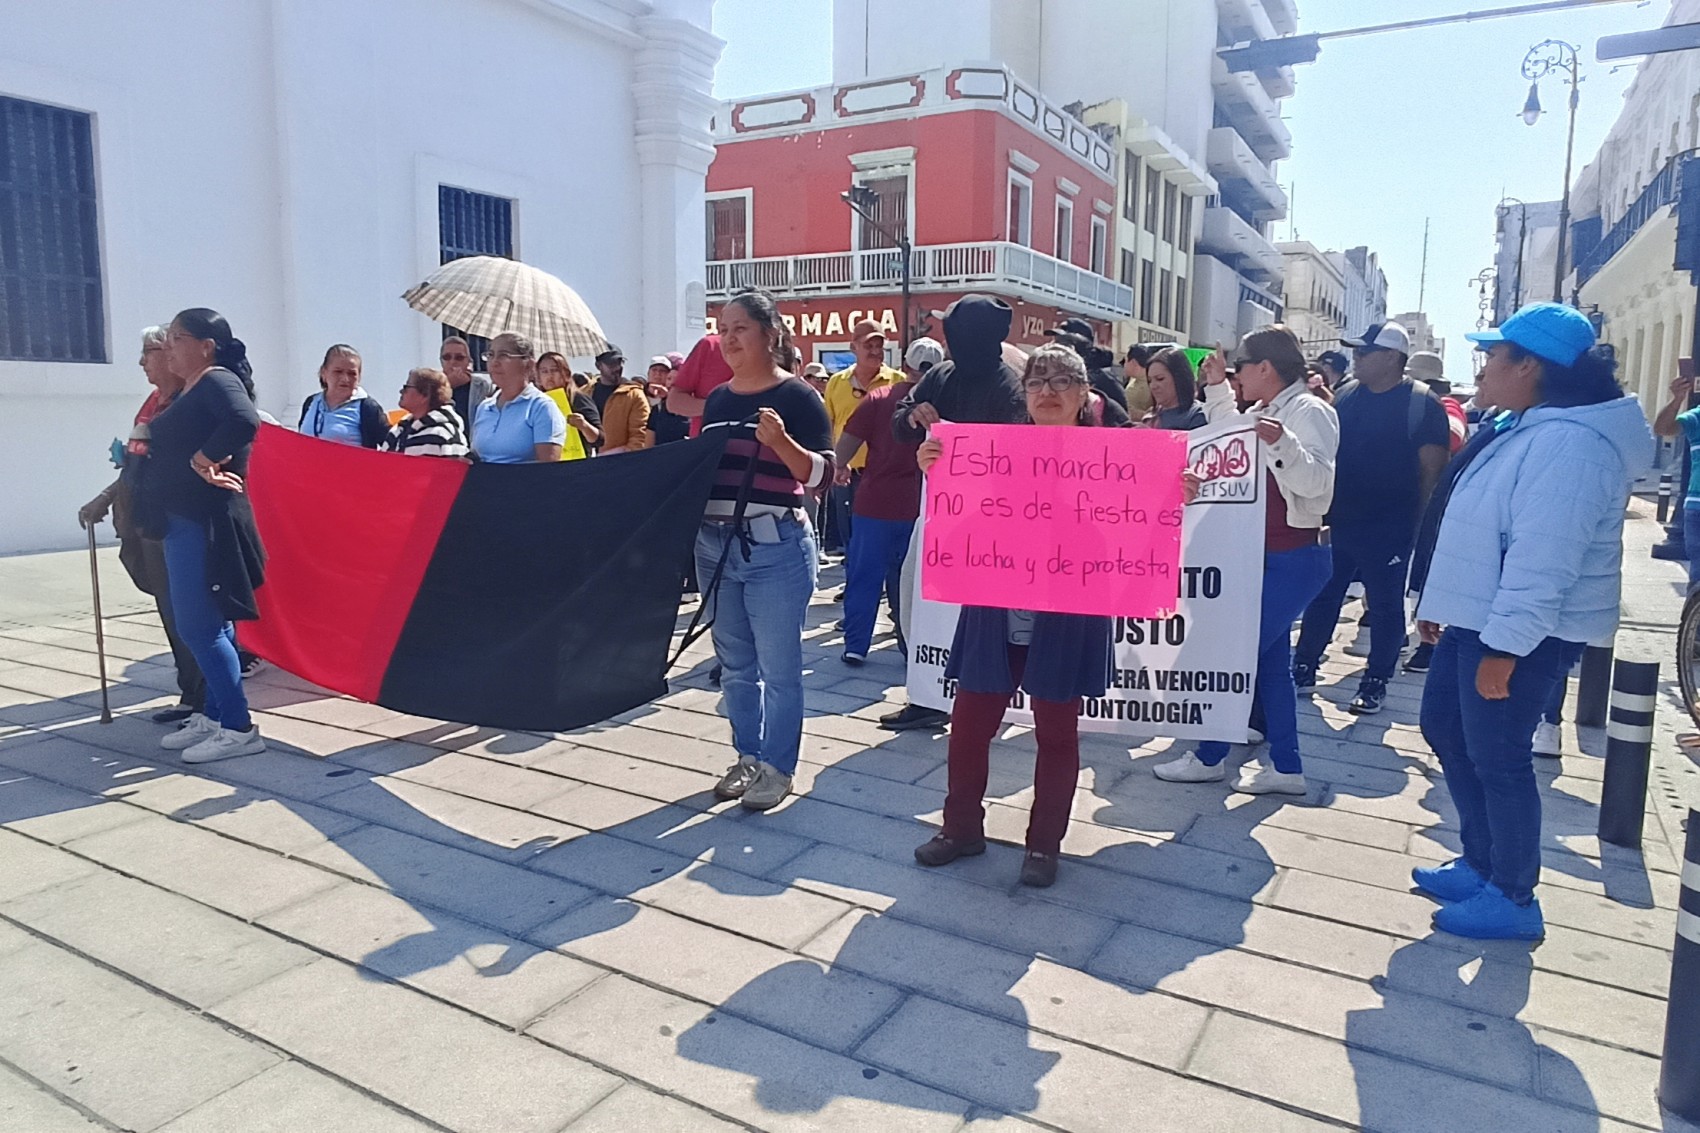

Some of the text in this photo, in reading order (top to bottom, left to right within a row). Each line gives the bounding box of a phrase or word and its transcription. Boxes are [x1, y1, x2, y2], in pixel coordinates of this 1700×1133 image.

[949, 435, 1137, 485] Esta marcha
[934, 490, 1183, 528] no es de fiesta es
[926, 533, 1170, 587] de lucha y de protesta
[1178, 566, 1222, 599] TO
[1107, 666, 1151, 690] ERÁ
[1155, 670, 1251, 694] VENCIDO!
